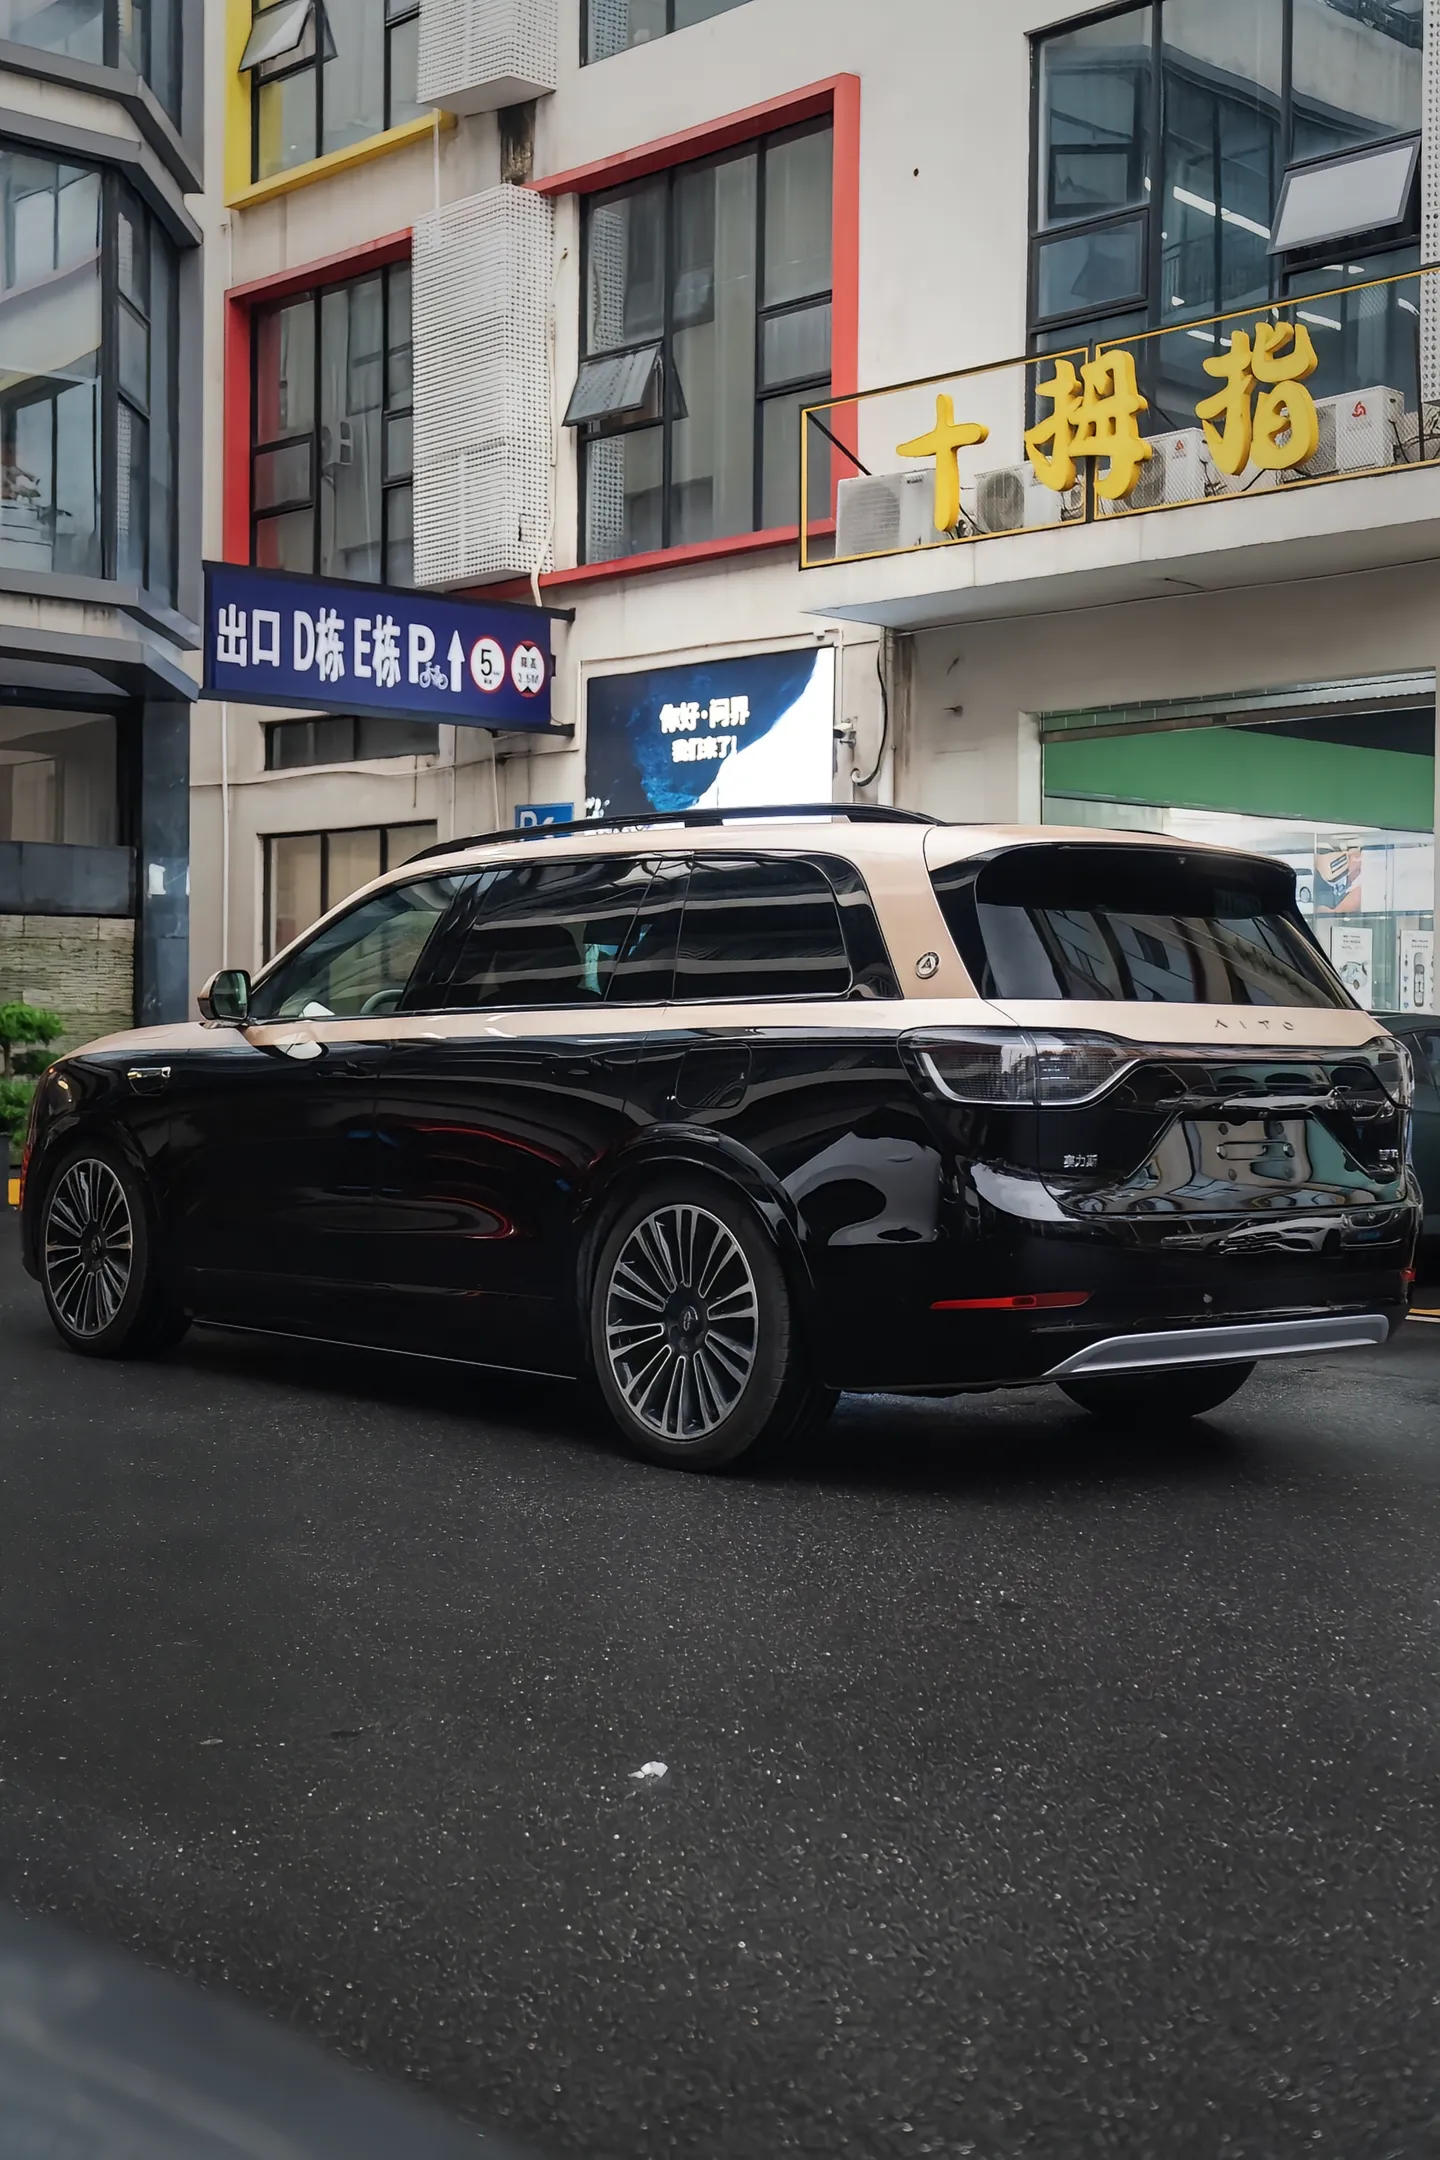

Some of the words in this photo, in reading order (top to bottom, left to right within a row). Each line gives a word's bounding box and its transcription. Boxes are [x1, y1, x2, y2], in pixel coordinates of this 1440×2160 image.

[896, 321, 1319, 533] 十拇指
[216, 603, 281, 668] 出口
[293, 607, 345, 682] D栋
[354, 614, 401, 688] E栋
[408, 623, 436, 684] P
[480, 648, 493, 676] 5
